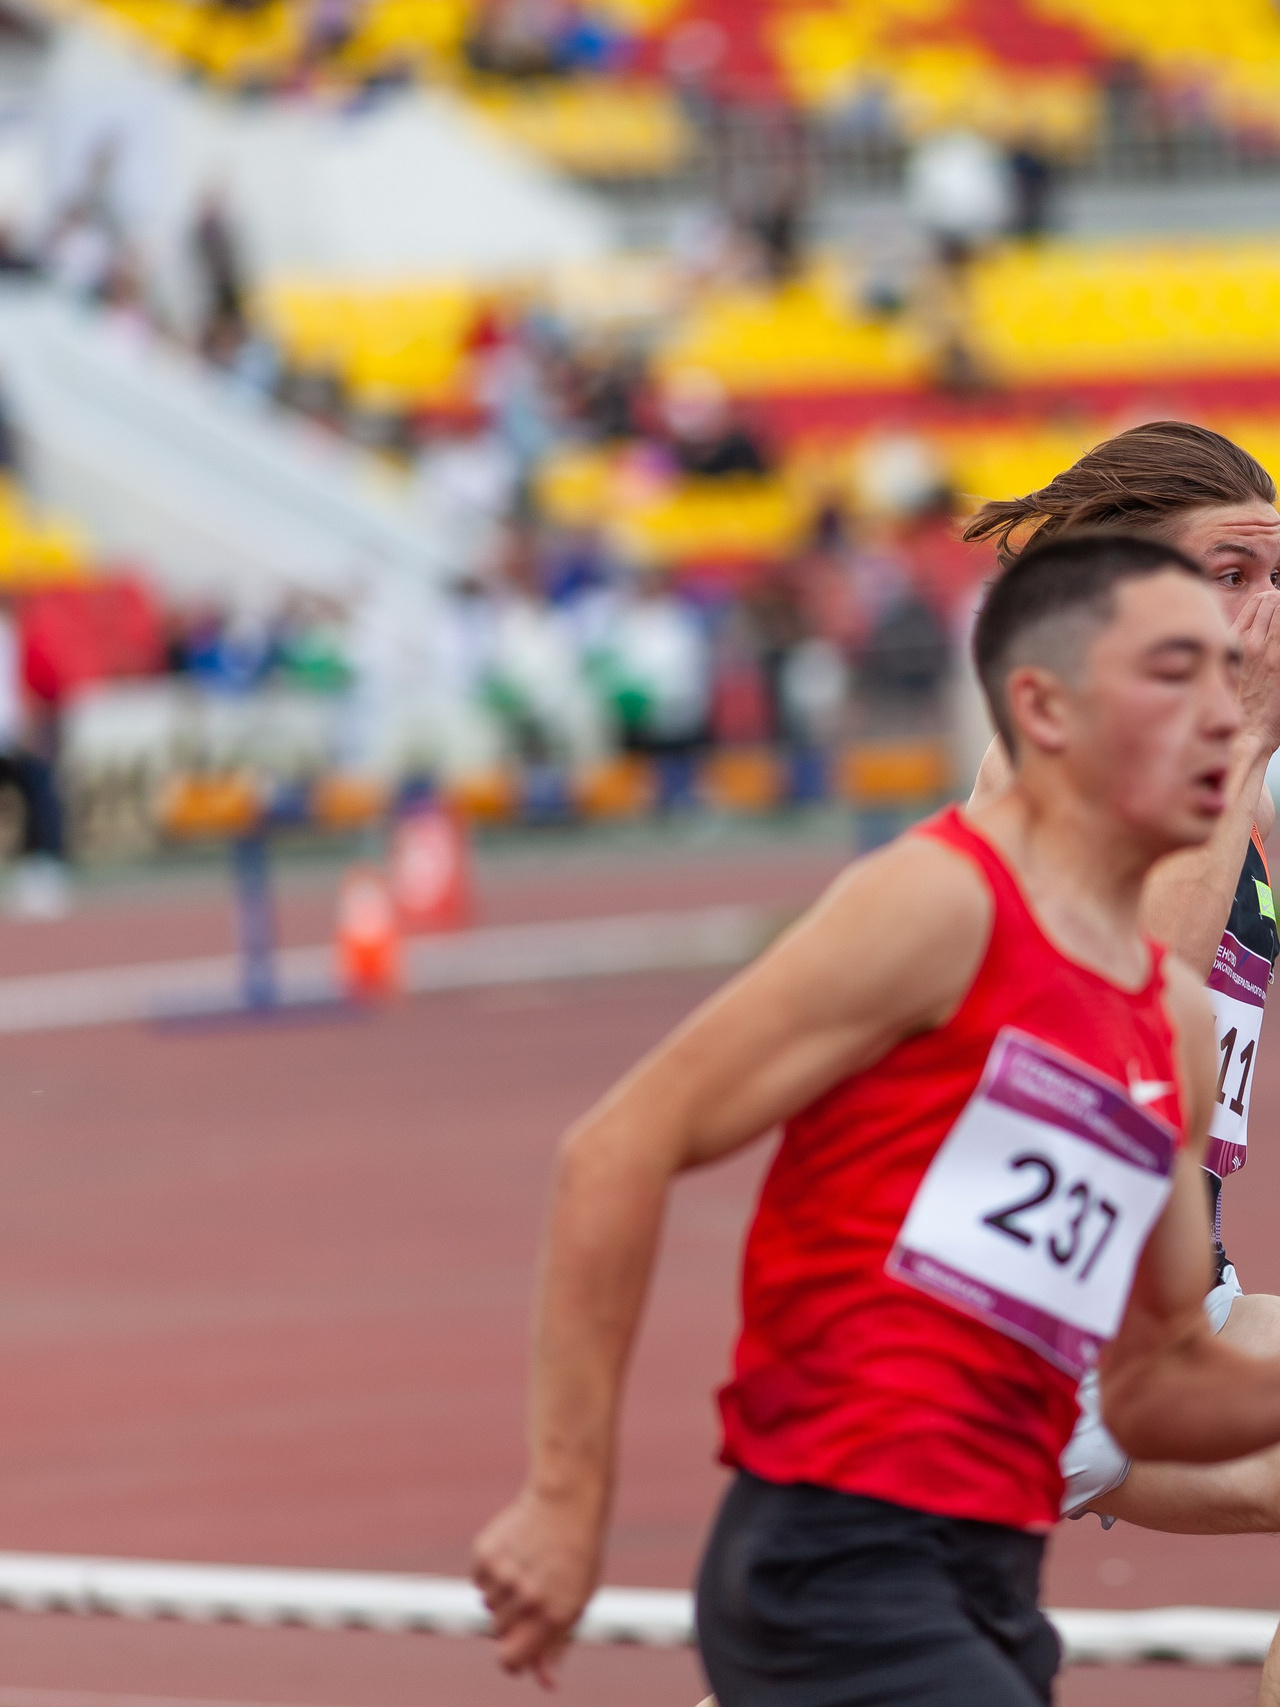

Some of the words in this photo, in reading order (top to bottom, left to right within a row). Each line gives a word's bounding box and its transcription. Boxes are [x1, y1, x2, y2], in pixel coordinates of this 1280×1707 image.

[1216, 944, 1237, 967] ЕНСТВО
[1214, 1025, 1256, 1117] 11
[981, 1151, 1119, 1283] 237
